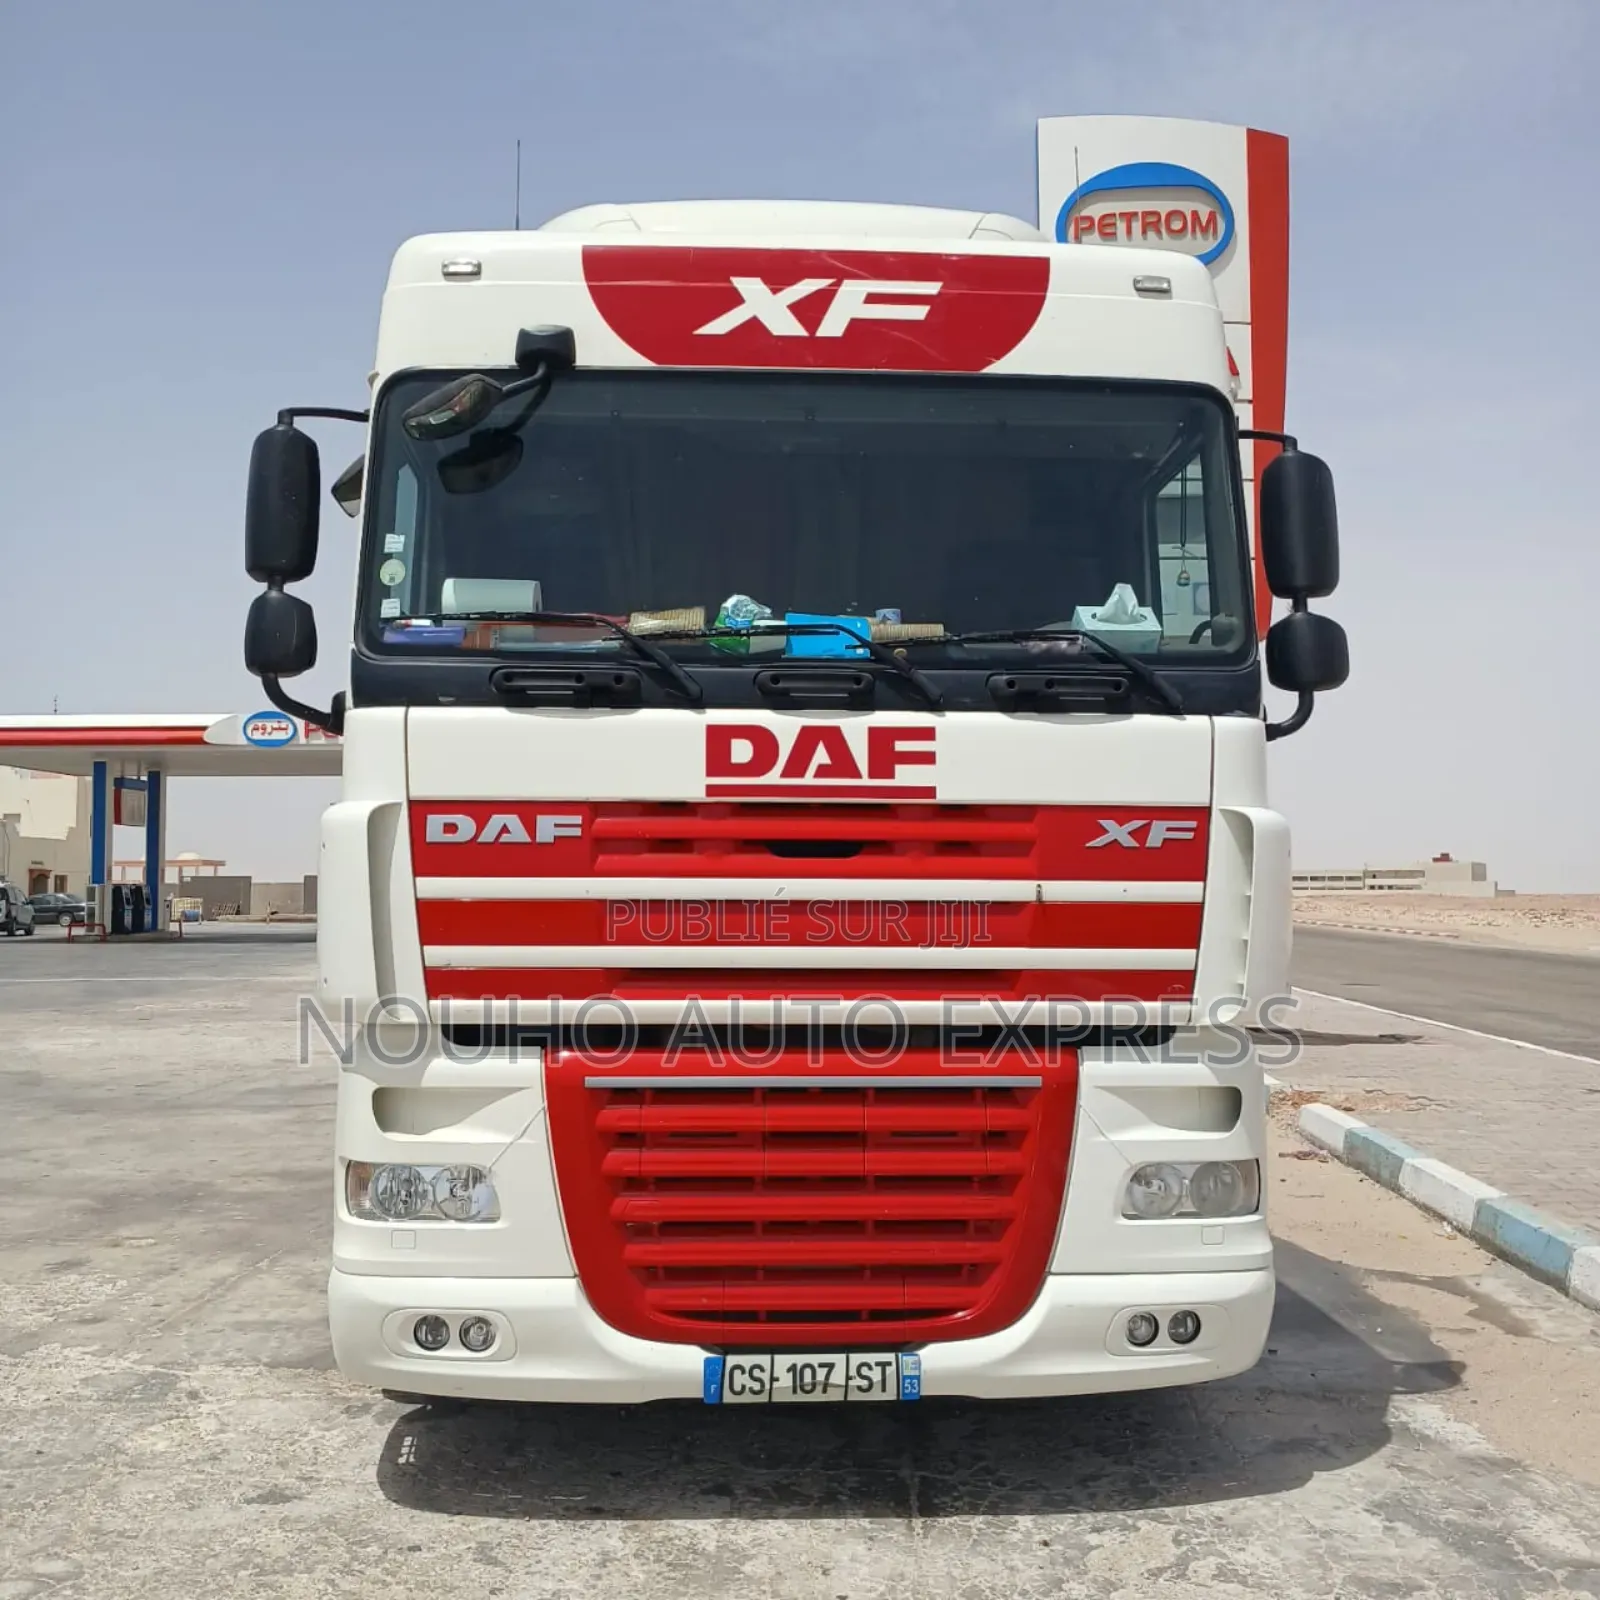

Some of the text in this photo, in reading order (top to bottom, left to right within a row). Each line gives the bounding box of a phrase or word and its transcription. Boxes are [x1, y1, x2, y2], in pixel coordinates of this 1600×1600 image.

[1073, 209, 1218, 242] PETROM
[692, 276, 944, 337] XF
[705, 724, 936, 780] DAF
[426, 814, 582, 843] DAF
[1085, 819, 1198, 847] XF
[904, 1379, 919, 1394] 53
